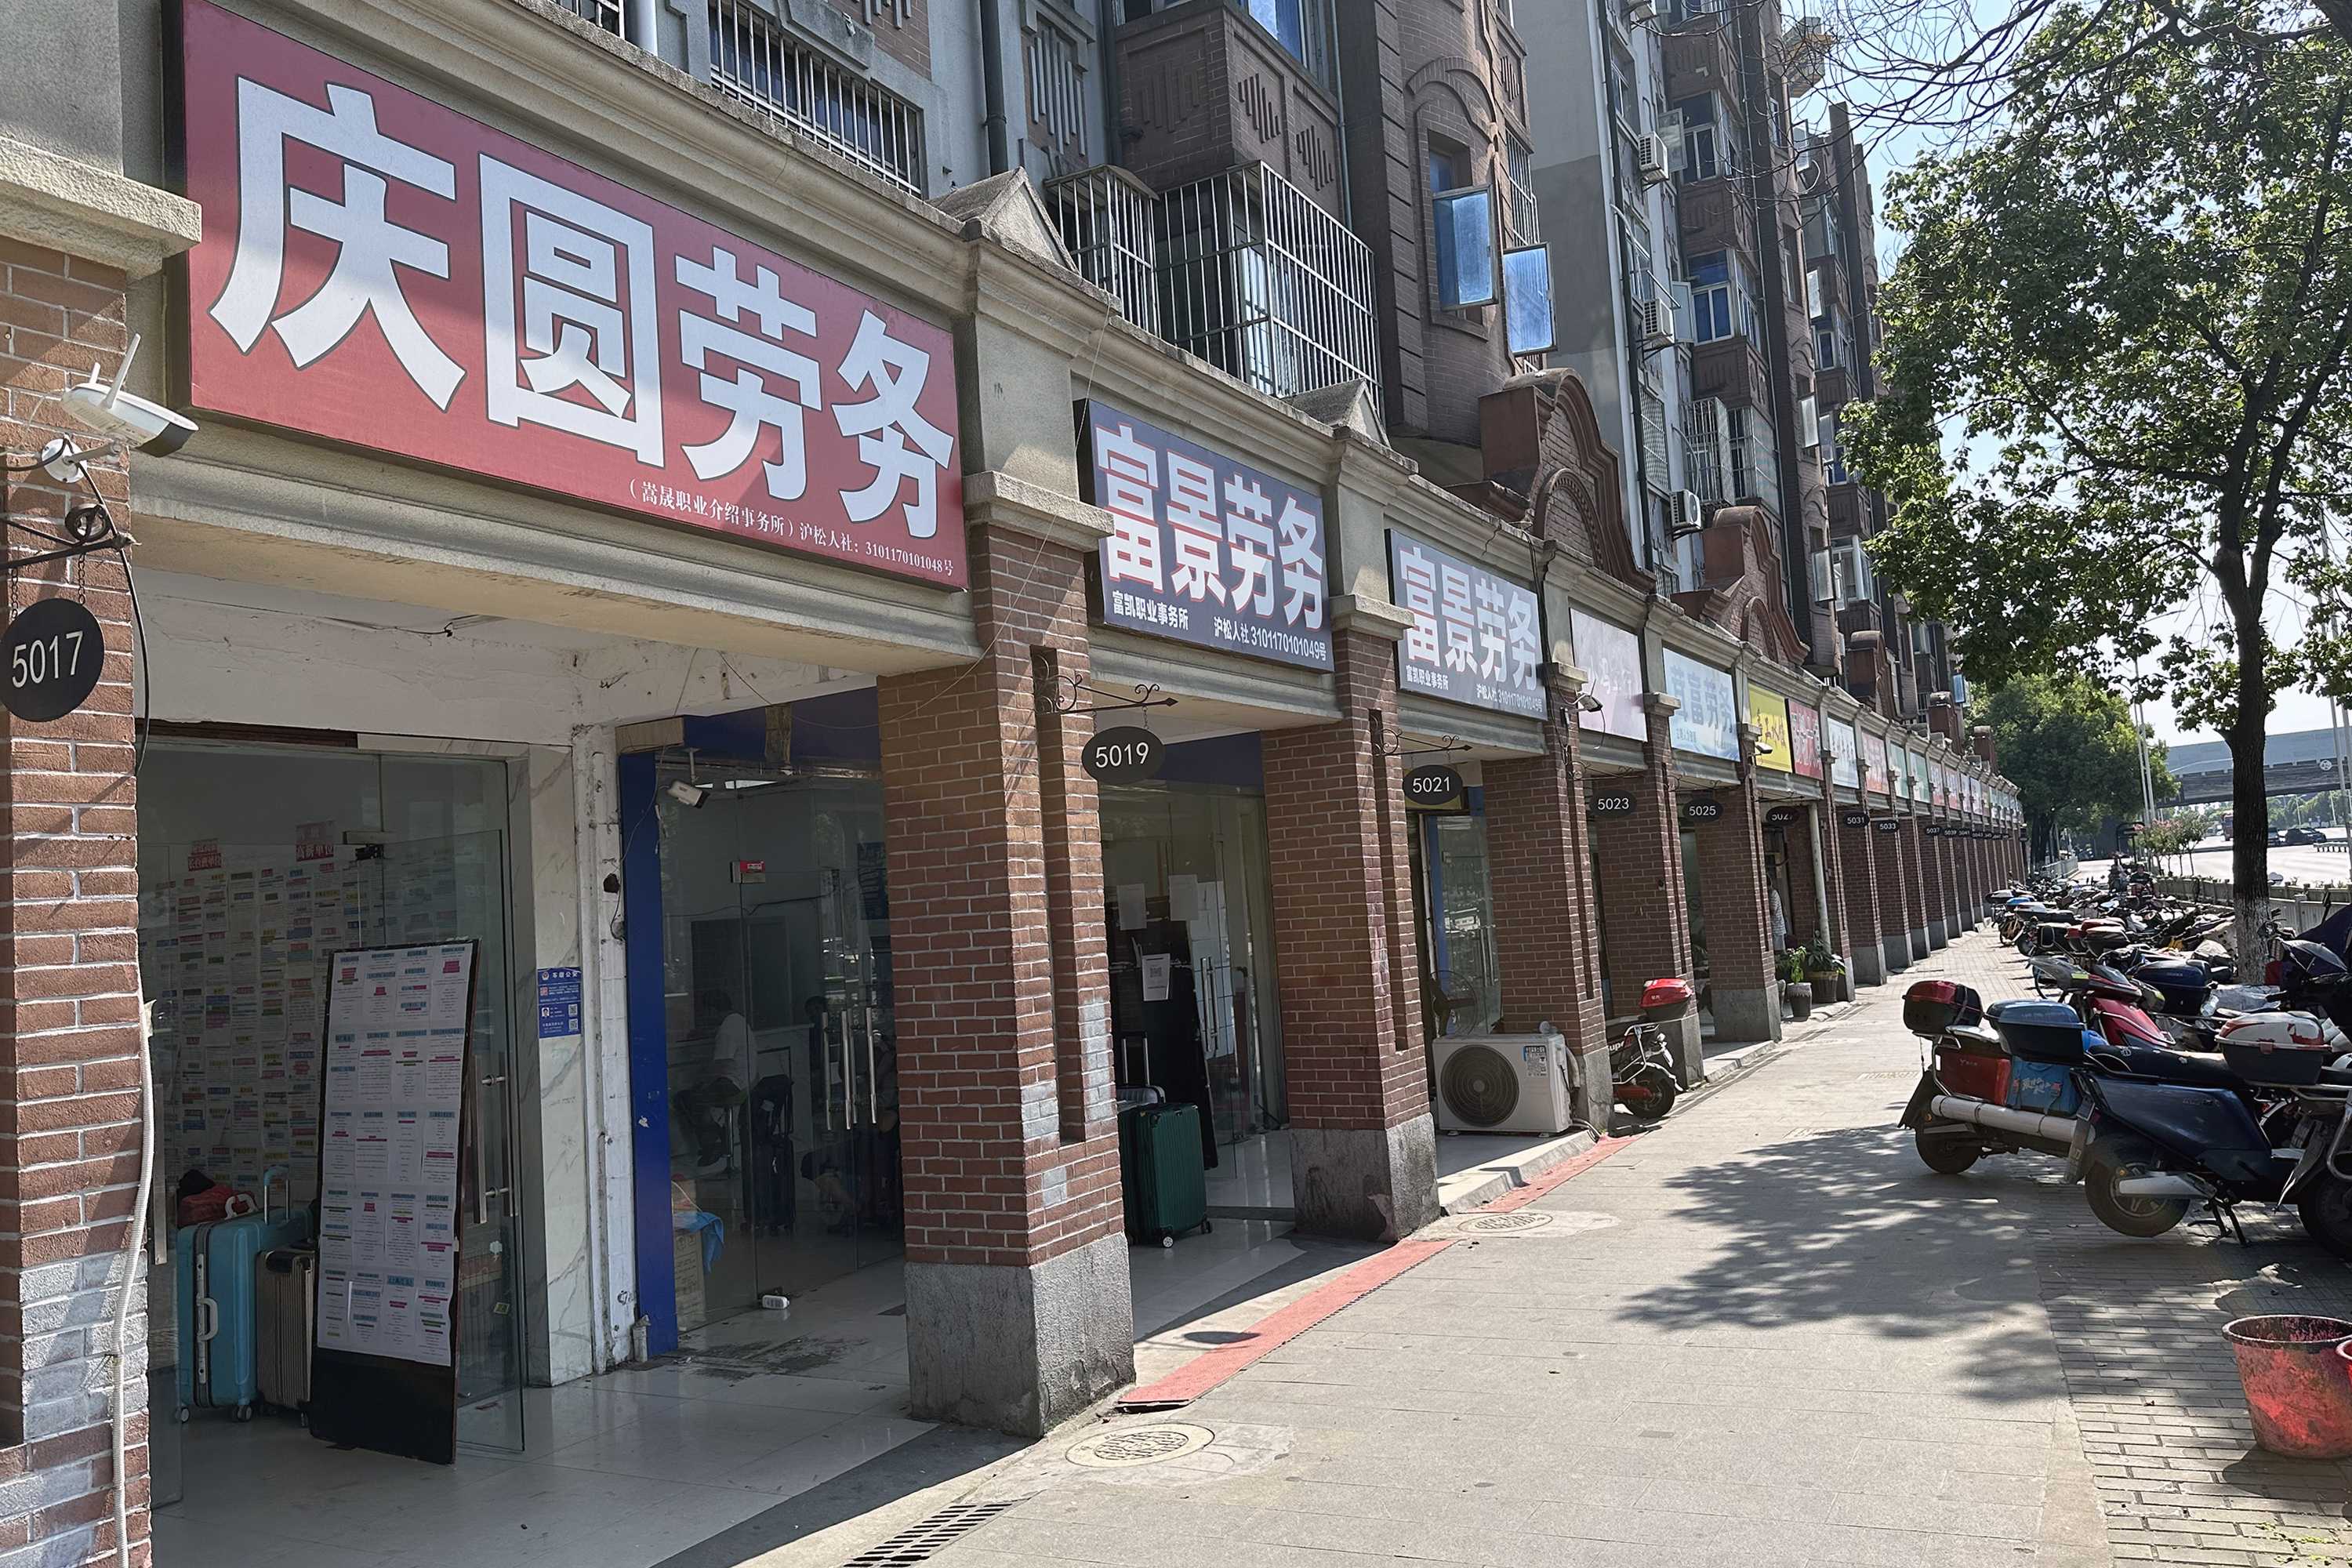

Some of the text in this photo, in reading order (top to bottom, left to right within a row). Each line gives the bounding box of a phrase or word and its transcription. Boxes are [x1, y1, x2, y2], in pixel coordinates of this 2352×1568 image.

[209, 75, 953, 539] 庆圆劳务
[1096, 423, 1323, 630] 富景劳务
[1112, 590, 1189, 630] 富凯职业事务所
[1399, 545, 1537, 691] 富景劳务
[12, 630, 84, 688] 5017
[1094, 742, 1150, 768] 5019
[1411, 776, 1451, 793] 5021
[1597, 797, 1630, 811] 5023
[1688, 804, 1717, 817] 5025
[1846, 815, 1865, 824] 5031
[1879, 822, 1896, 831] 5033
